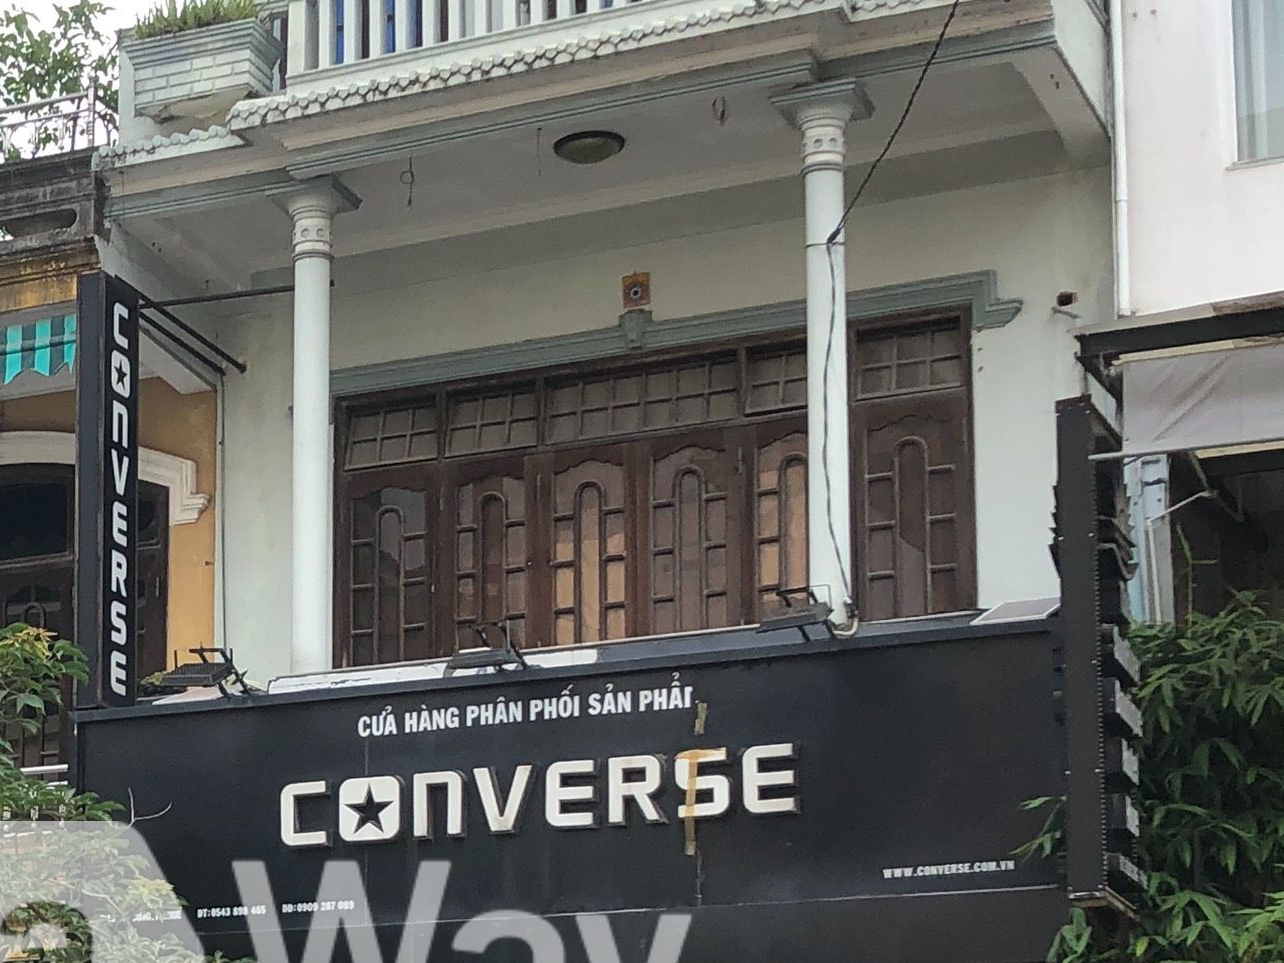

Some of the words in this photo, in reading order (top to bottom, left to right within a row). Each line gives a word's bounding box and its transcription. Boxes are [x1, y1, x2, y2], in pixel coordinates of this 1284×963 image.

[404, 706, 459, 734] HÀNG
[466, 697, 523, 727] PHÂN
[530, 684, 580, 722] PHỐI
[588, 682, 631, 715] SẢN
[281, 742, 800, 847] CONVERSE
[882, 860, 1015, 879] WWW.CONVERSE.COM.VN
